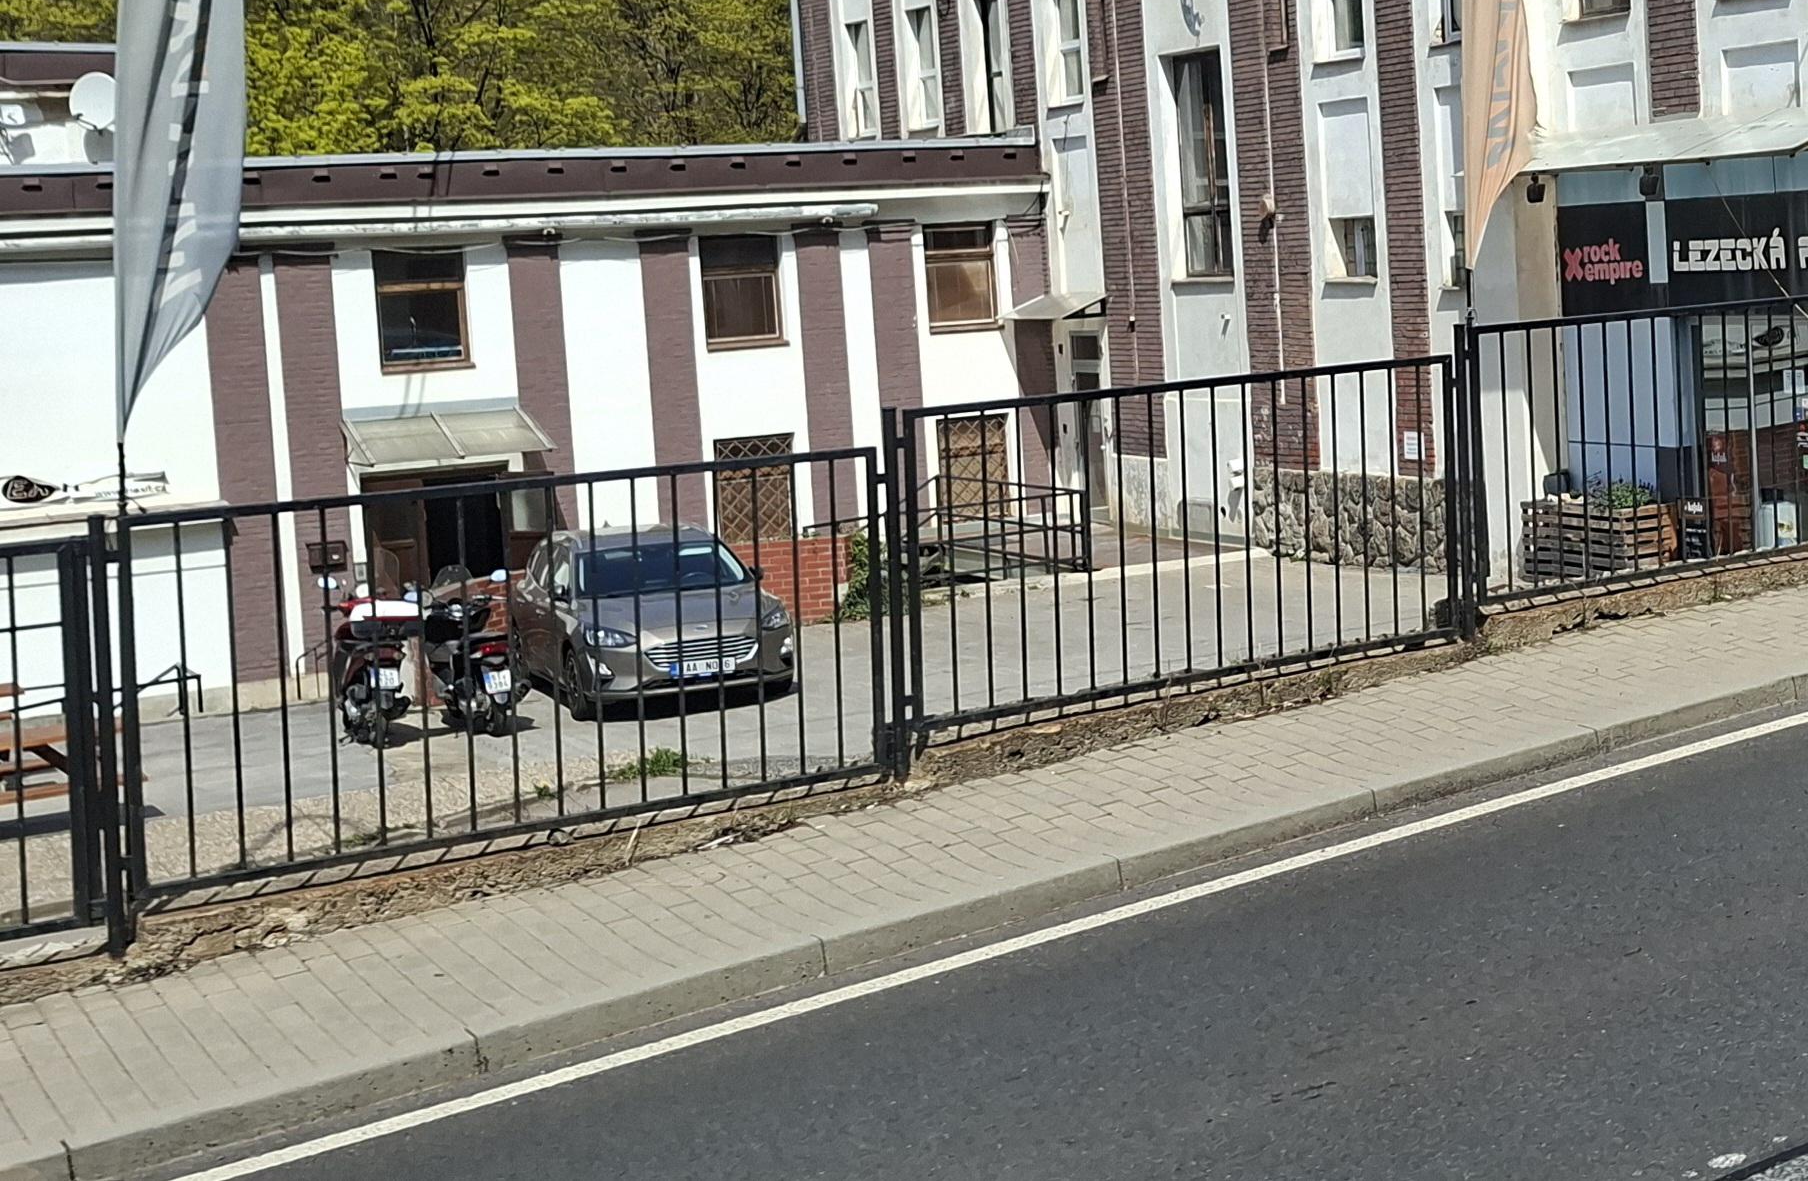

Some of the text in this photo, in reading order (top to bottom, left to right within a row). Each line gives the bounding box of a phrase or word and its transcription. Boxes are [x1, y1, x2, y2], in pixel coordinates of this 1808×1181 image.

[1583, 238, 1621, 263] rock
[1673, 227, 1787, 272] LEZECKÁ
[1584, 260, 1643, 286] empire
